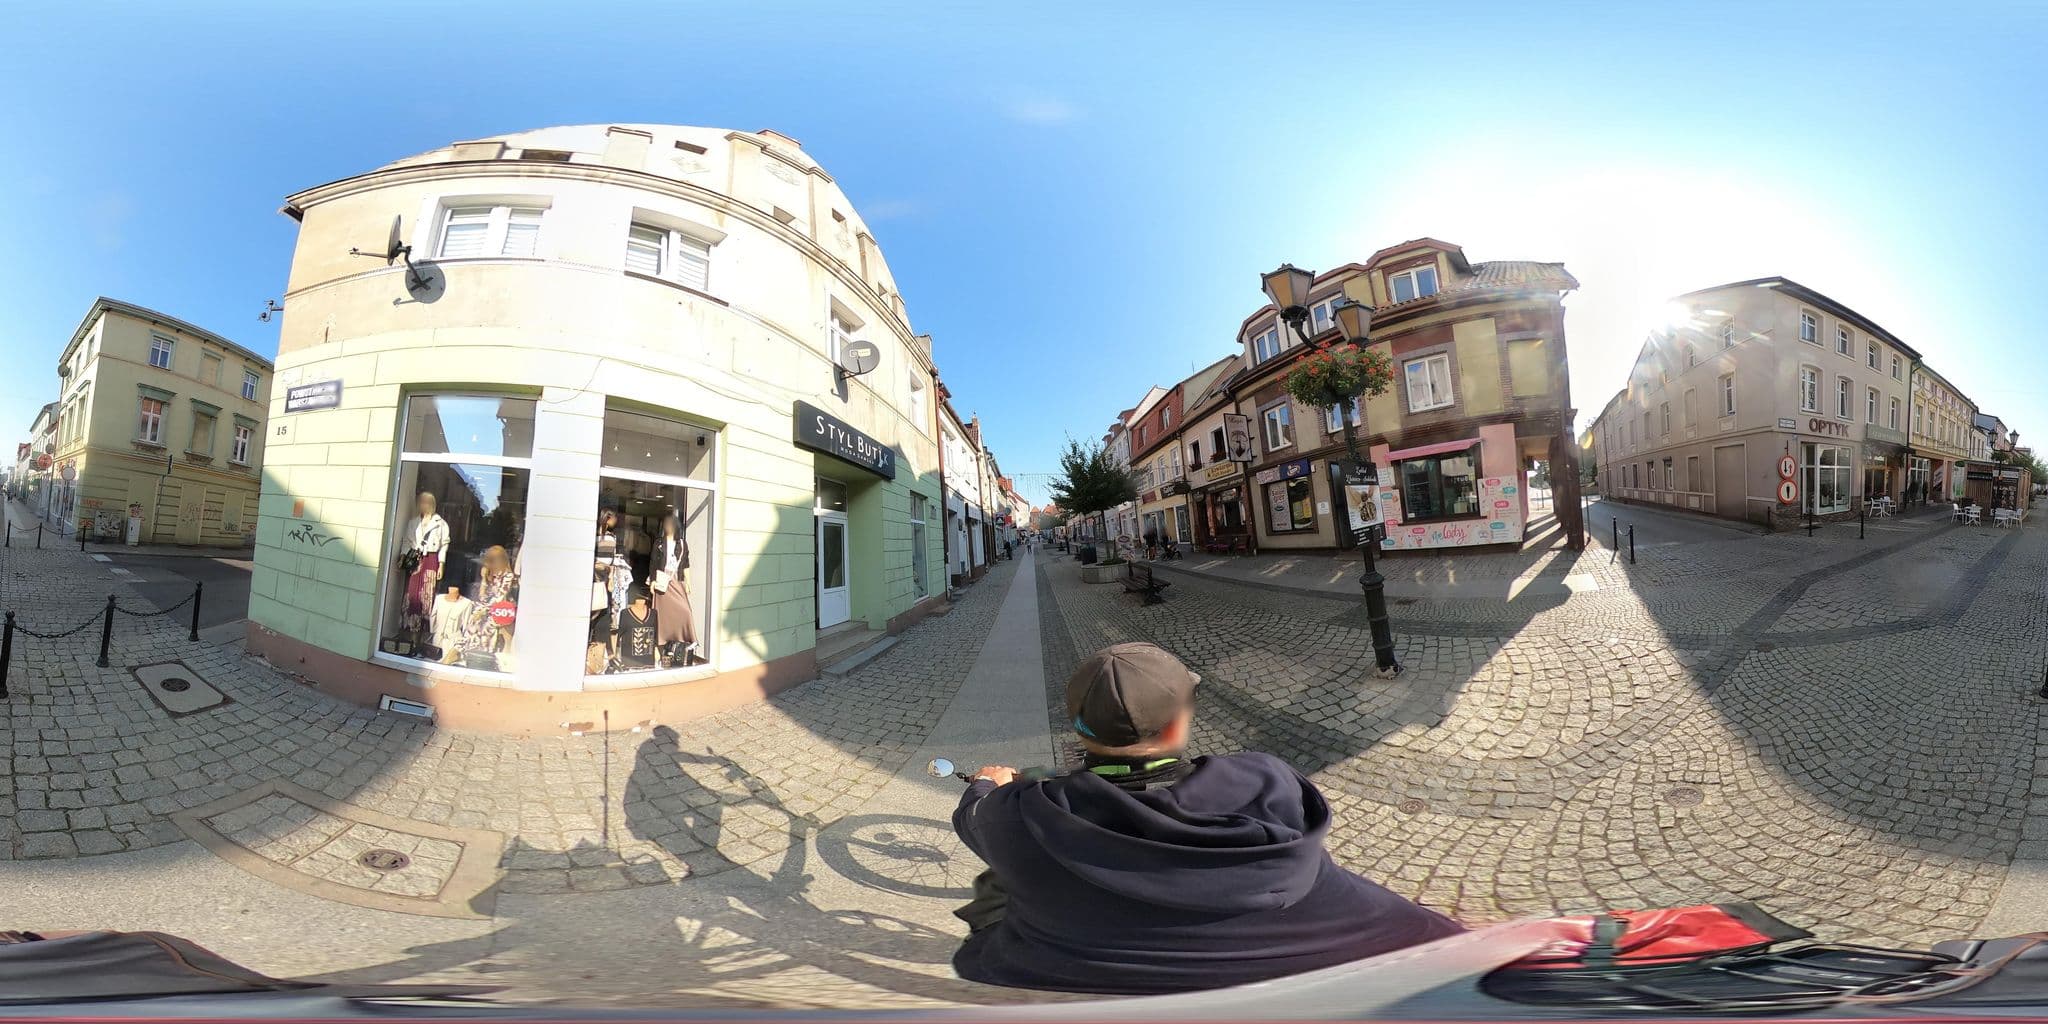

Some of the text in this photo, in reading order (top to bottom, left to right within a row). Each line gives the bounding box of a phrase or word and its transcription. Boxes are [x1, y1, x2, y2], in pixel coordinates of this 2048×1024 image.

[277, 426, 287, 436] 15
[1808, 418, 1850, 437] OPTYK
[816, 415, 889, 468] STYL BUTIK
[491, 608, 516, 617] -50%
